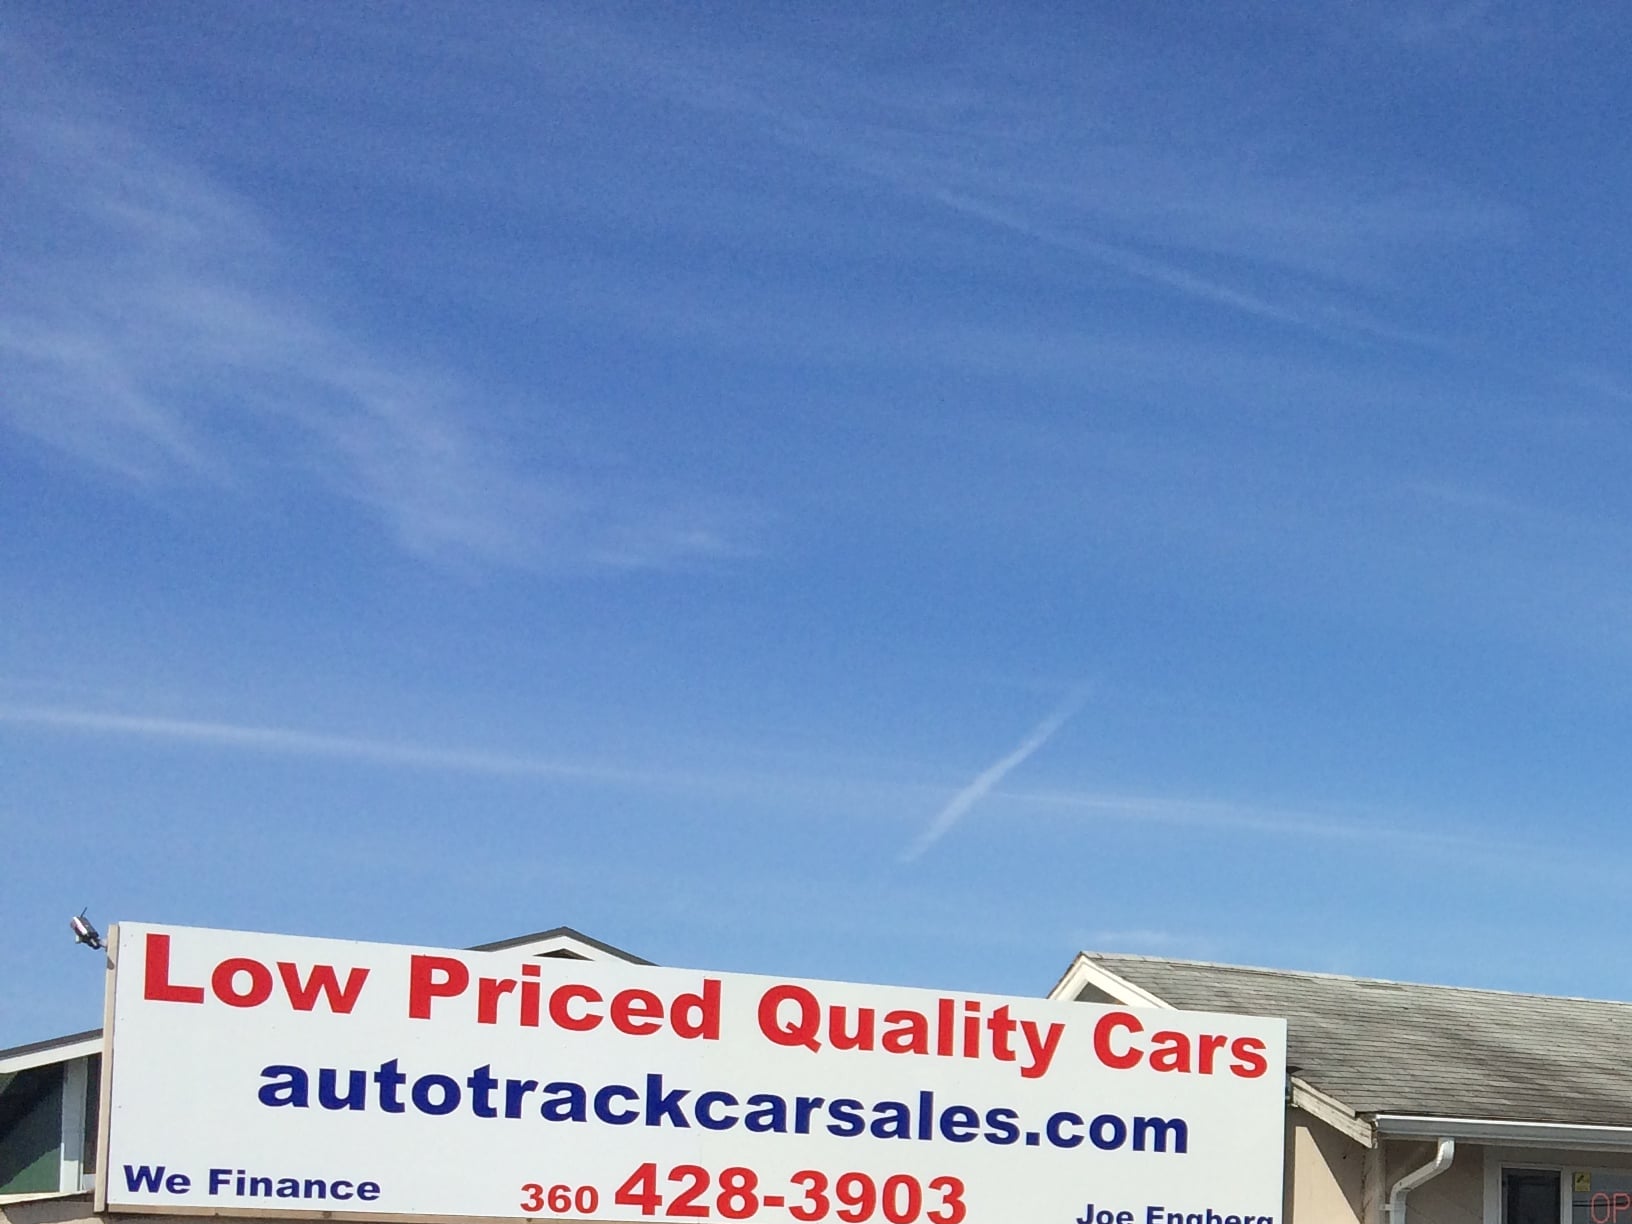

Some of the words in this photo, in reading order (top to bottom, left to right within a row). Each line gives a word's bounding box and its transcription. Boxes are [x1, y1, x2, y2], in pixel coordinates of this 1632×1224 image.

[143, 932, 370, 1014] Low
[408, 954, 722, 1041] Priced
[757, 984, 1065, 1079] Quality
[1092, 1011, 1269, 1079] Cars
[257, 1058, 1188, 1153] autotrackcarsales.com
[123, 1165, 191, 1194] We
[208, 1168, 381, 1201] Finance
[520, 1183, 599, 1214] 360
